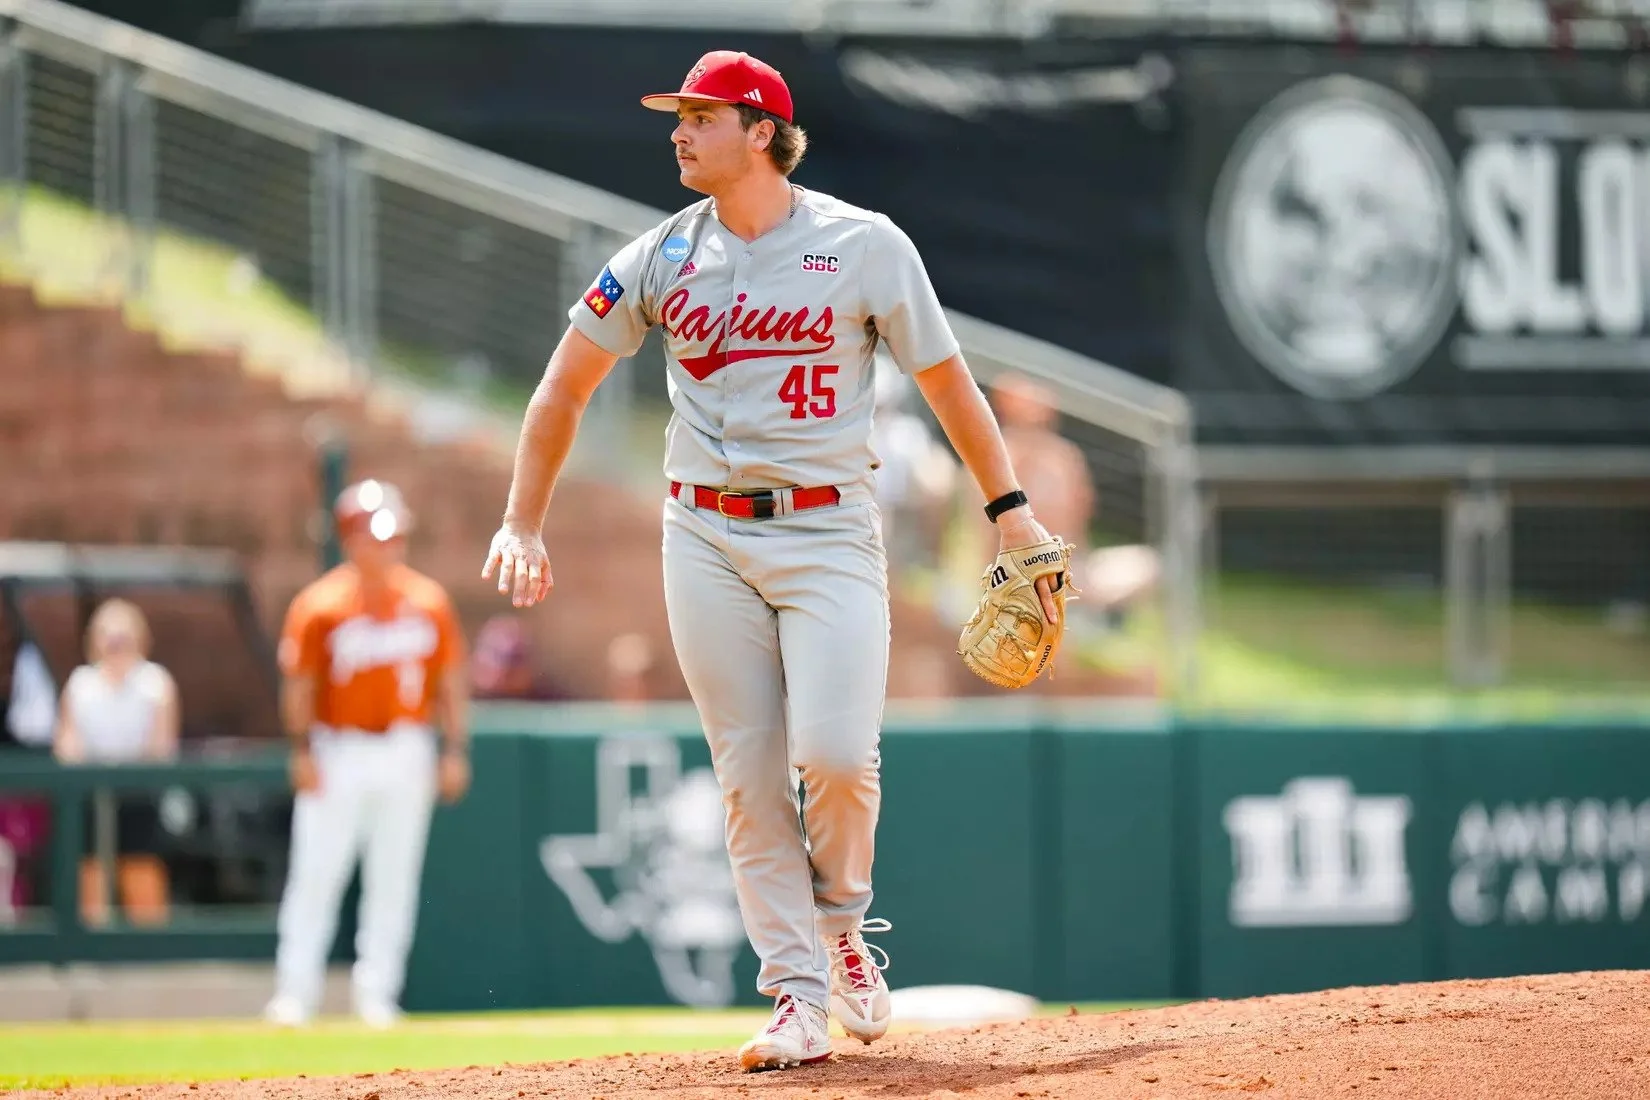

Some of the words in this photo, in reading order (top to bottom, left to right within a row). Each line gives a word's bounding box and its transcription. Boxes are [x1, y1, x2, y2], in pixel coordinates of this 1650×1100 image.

[802, 254, 839, 273] SBC
[1459, 140, 1650, 334] SLO
[661, 288, 835, 362] Cajuns
[777, 365, 840, 419] 45
[1022, 550, 1062, 567] Wilson
